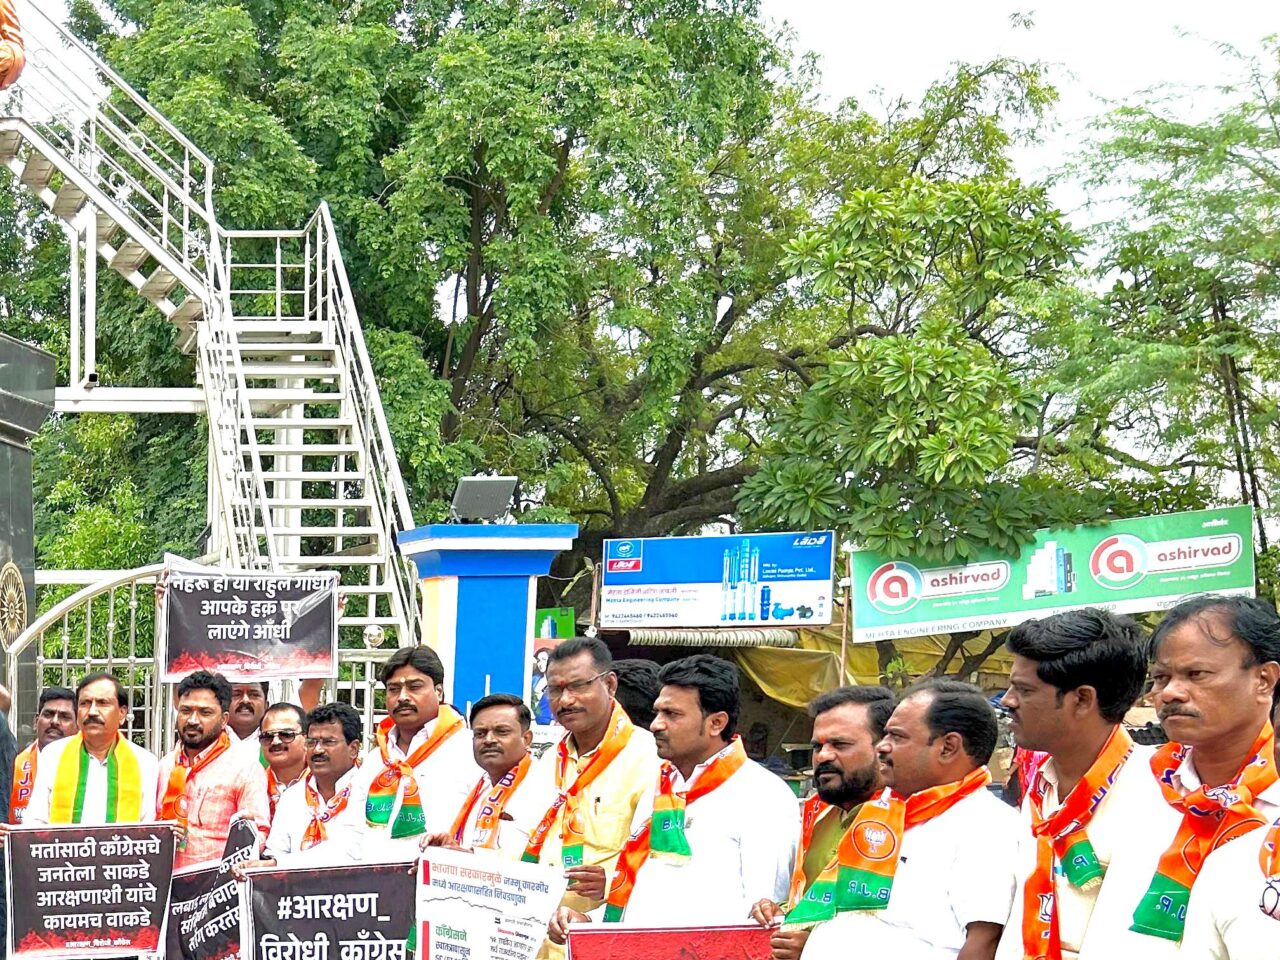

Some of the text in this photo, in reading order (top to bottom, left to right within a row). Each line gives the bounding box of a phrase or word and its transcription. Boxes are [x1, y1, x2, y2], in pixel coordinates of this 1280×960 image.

[1157, 542, 1233, 563] ashirvad
[930, 568, 1001, 588] ashirvad
[200, 595, 248, 616] आपके
[207, 620, 250, 640] लाएंगे
[898, 623, 960, 636] ENGINEERING
[962, 618, 1008, 629] COMPANY
[29, 833, 161, 859] मतांसाठी काँग्रेसचे
[38, 860, 151, 883] जनतेला साकडे
[36, 882, 158, 909] आरक्षणाशी यांचे
[43, 907, 152, 931] कायमच वाकडे
